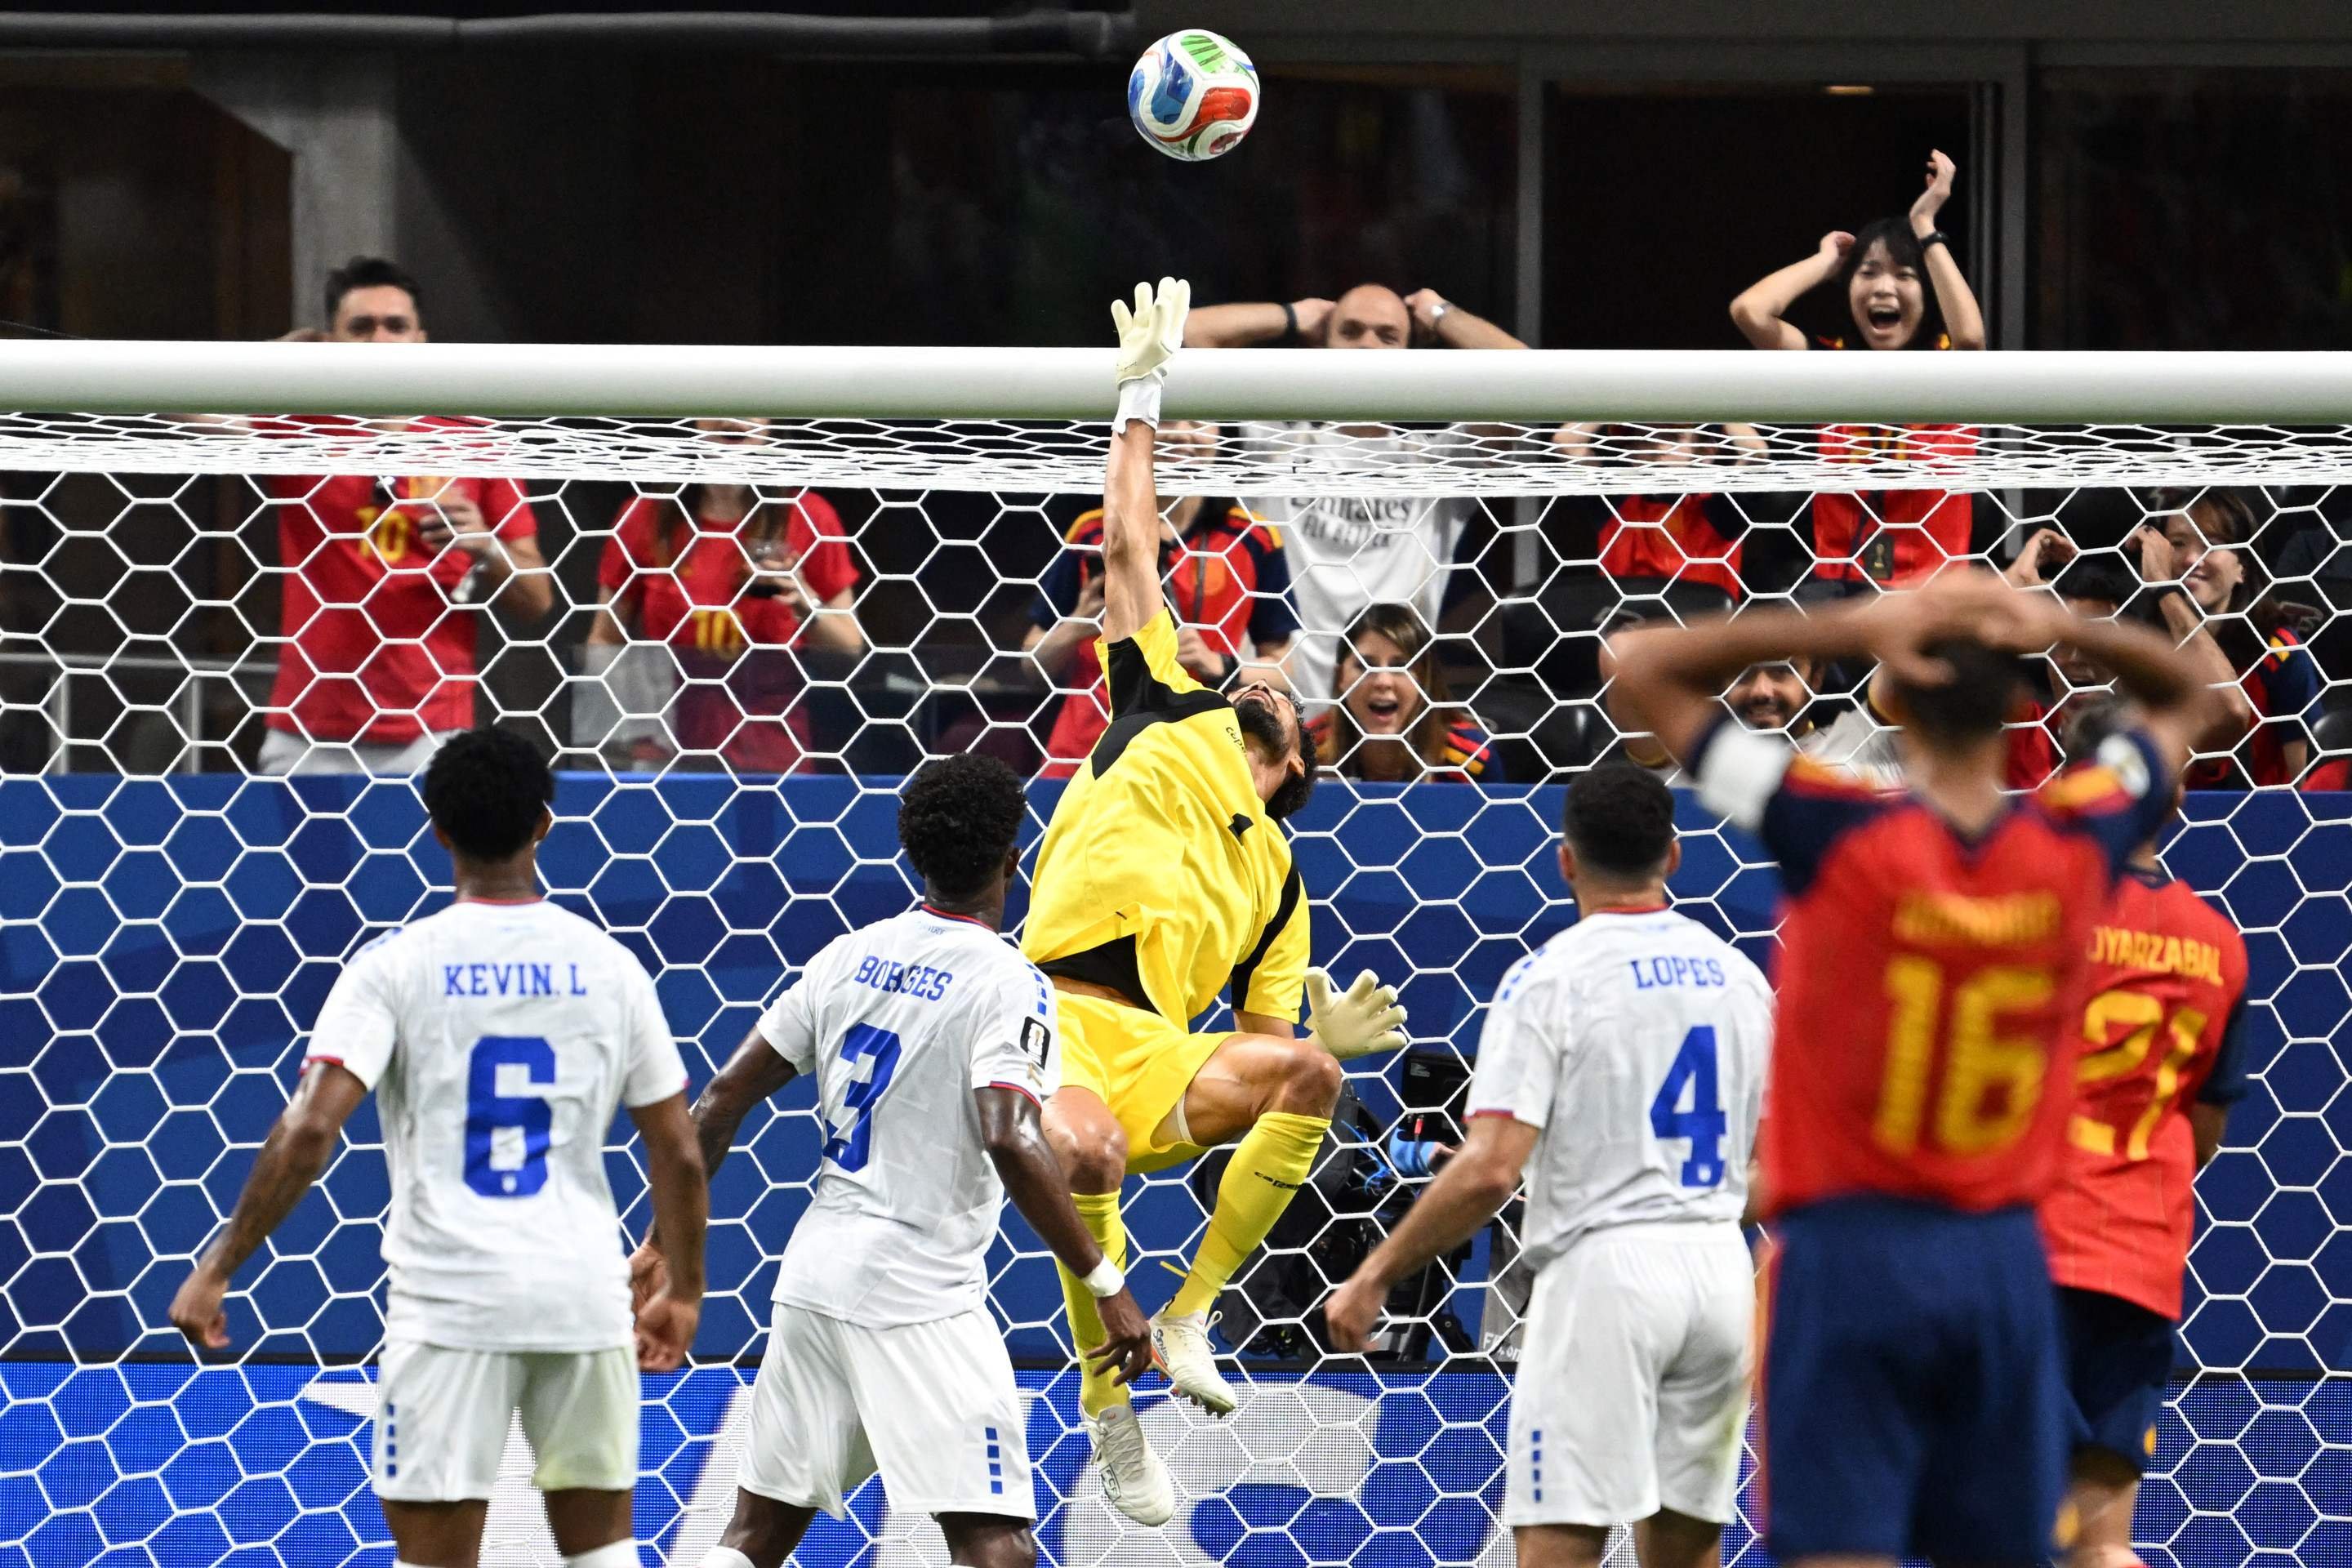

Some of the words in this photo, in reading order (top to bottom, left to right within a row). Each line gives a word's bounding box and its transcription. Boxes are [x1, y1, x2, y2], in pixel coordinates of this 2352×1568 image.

[354, 507, 409, 564] 10
[691, 607, 742, 662] 10
[854, 955, 953, 1002] BORGES
[1631, 956, 1726, 989] LOPES
[462, 1036, 555, 1197] 6
[822, 1022, 902, 1174] 3
[1650, 1026, 1726, 1187] 4
[1873, 954, 2056, 1158] 16
[2068, 989, 2207, 1161] 21
